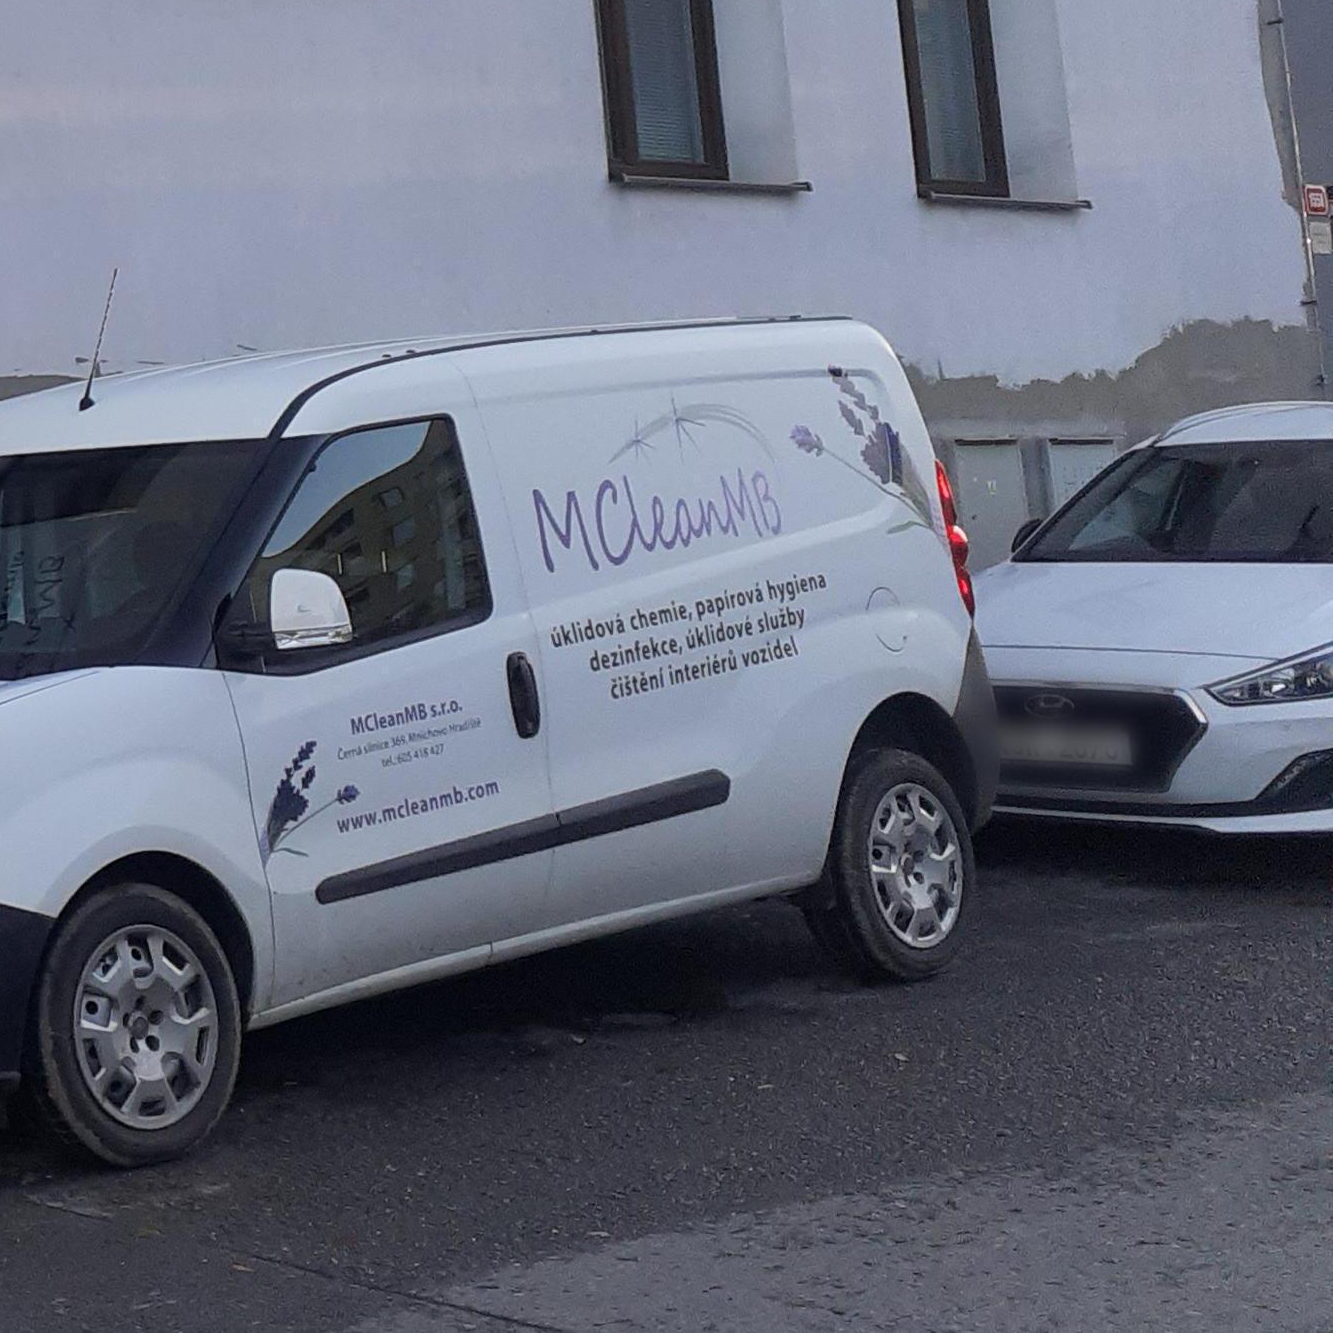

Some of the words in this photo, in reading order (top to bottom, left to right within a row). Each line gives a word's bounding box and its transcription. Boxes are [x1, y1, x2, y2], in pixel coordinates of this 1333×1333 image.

[532, 468, 782, 574] MCleanMB
[550, 612, 626, 648] úklidová
[629, 600, 694, 631] chemie,
[695, 586, 764, 618] papírová
[766, 572, 827, 602] hygiena
[589, 639, 683, 672] dezinfekce,
[685, 618, 754, 651] úklidové
[758, 606, 806, 634] služby
[610, 666, 665, 700] čištění
[668, 649, 738, 685] interiérů
[741, 635, 799, 668] vozidel
[350, 702, 428, 735] MCleanMB
[430, 699, 463, 718] s.r.o.
[336, 781, 500, 834] www.mcleanmb.com
